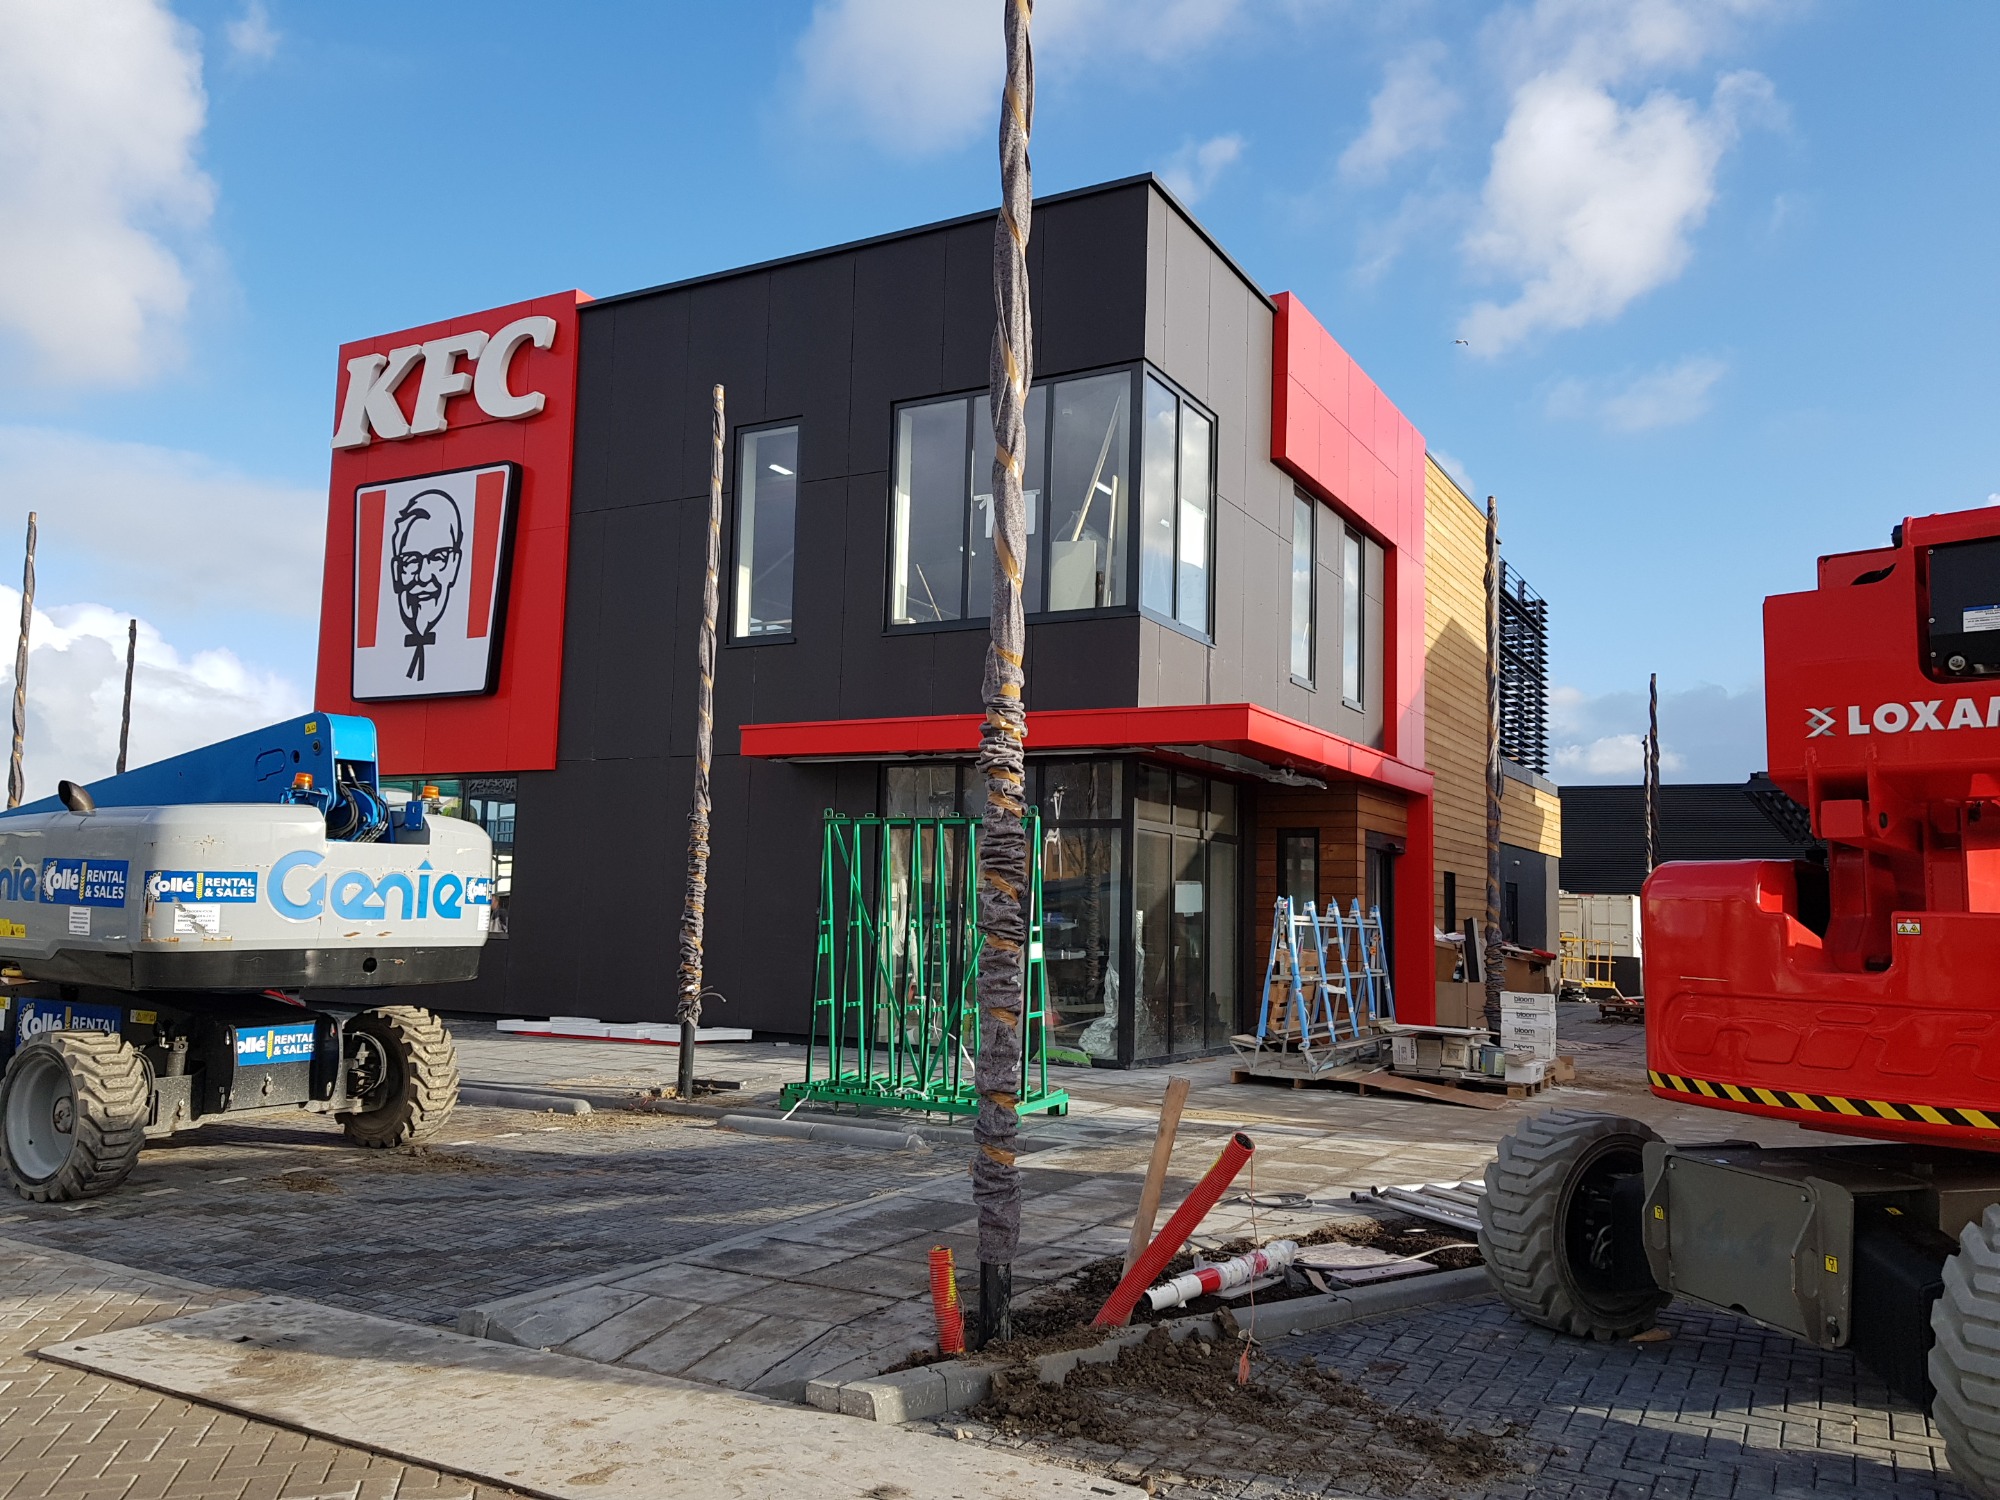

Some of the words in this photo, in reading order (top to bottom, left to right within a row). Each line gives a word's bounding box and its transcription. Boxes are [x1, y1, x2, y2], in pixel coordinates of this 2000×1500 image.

[331, 316, 556, 449] KFC
[45, 865, 79, 896] Collé
[86, 869, 125, 883] RENTAL
[205, 878, 255, 888] RENTAL
[85, 885, 92, 896] &
[94, 885, 124, 899] SALES
[149, 875, 194, 897] Collé
[267, 850, 464, 920] Genie
[204, 888, 213, 897] &
[216, 888, 255, 897] SALES
[237, 1035, 266, 1054] ollé
[274, 1033, 314, 1044] RENTAL
[273, 1046, 281, 1055] &
[283, 1043, 314, 1054] SALES
